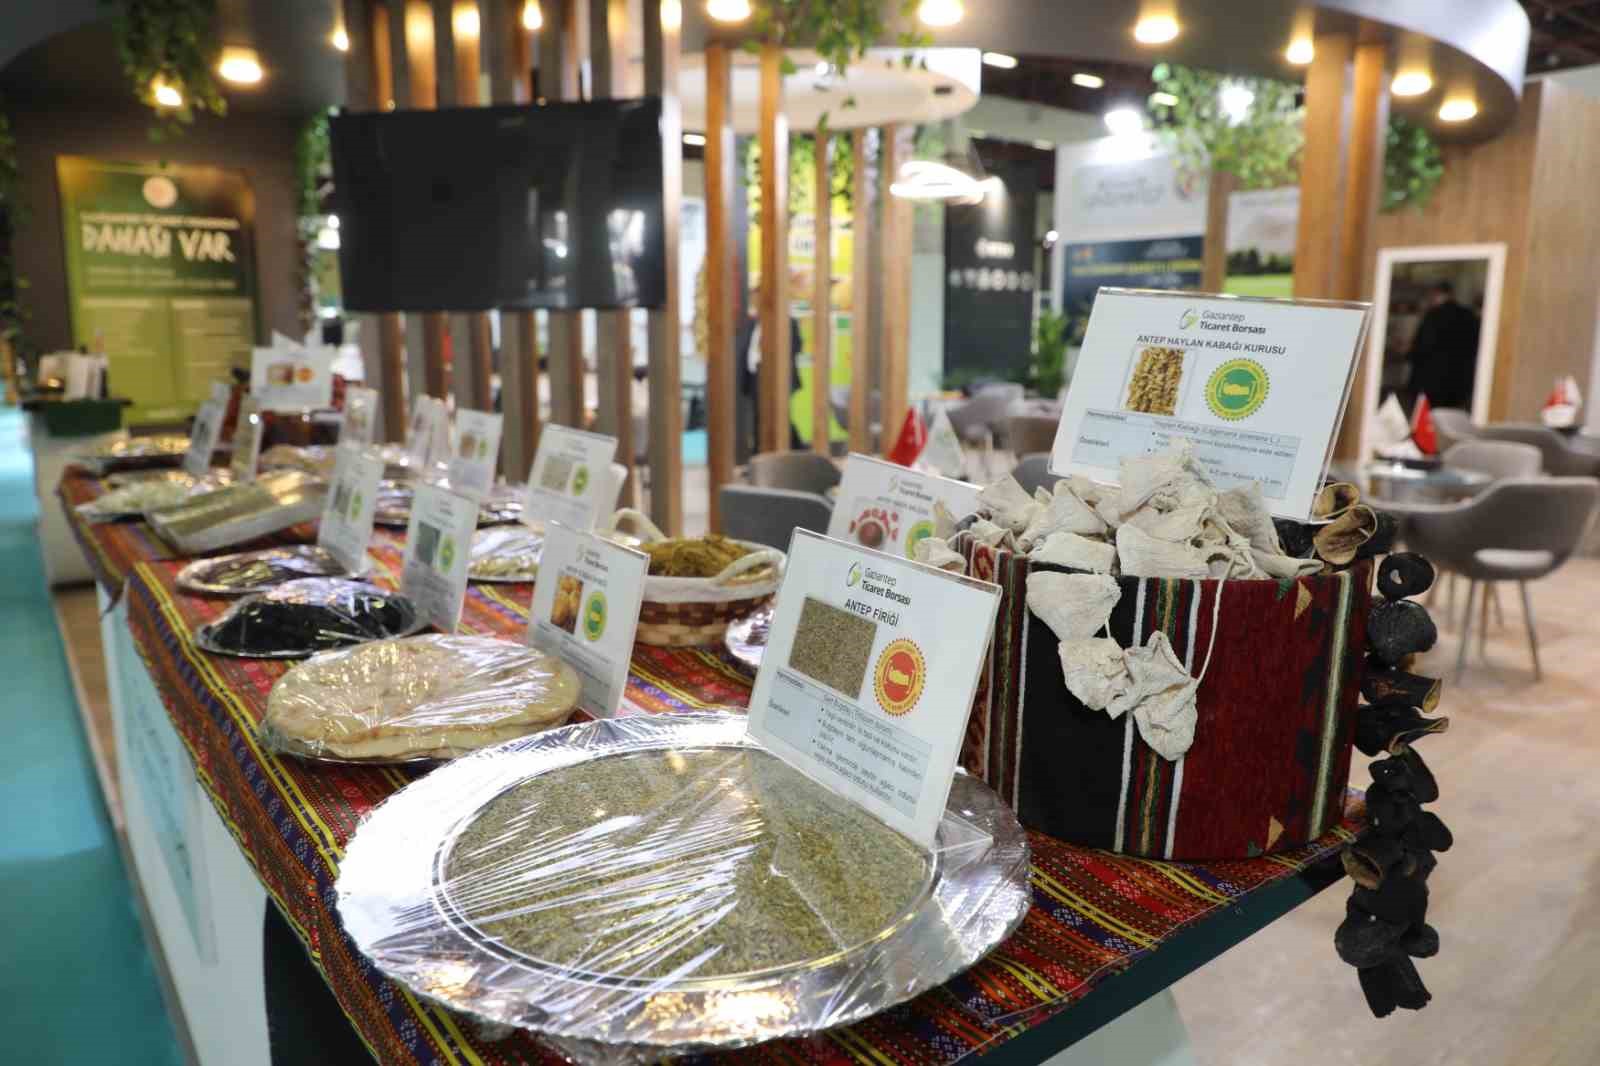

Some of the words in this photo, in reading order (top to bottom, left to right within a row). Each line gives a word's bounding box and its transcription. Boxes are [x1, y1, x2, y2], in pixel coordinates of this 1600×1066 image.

[177, 230, 237, 262] VAR
[1199, 320, 1230, 332] Ticaret
[1232, 323, 1266, 334] Borsası
[1201, 310, 1246, 323] Gaziantep
[1136, 335, 1166, 344] ANTEP
[1167, 336, 1203, 348] HAYLAN
[1205, 340, 1242, 351] KABAĞI
[1243, 343, 1286, 355] KURUSU
[862, 579, 885, 597] Ticaret
[885, 588, 911, 605] Borsası
[844, 598, 872, 616] ANTEP
[873, 607, 900, 627] FİRİĞİ
